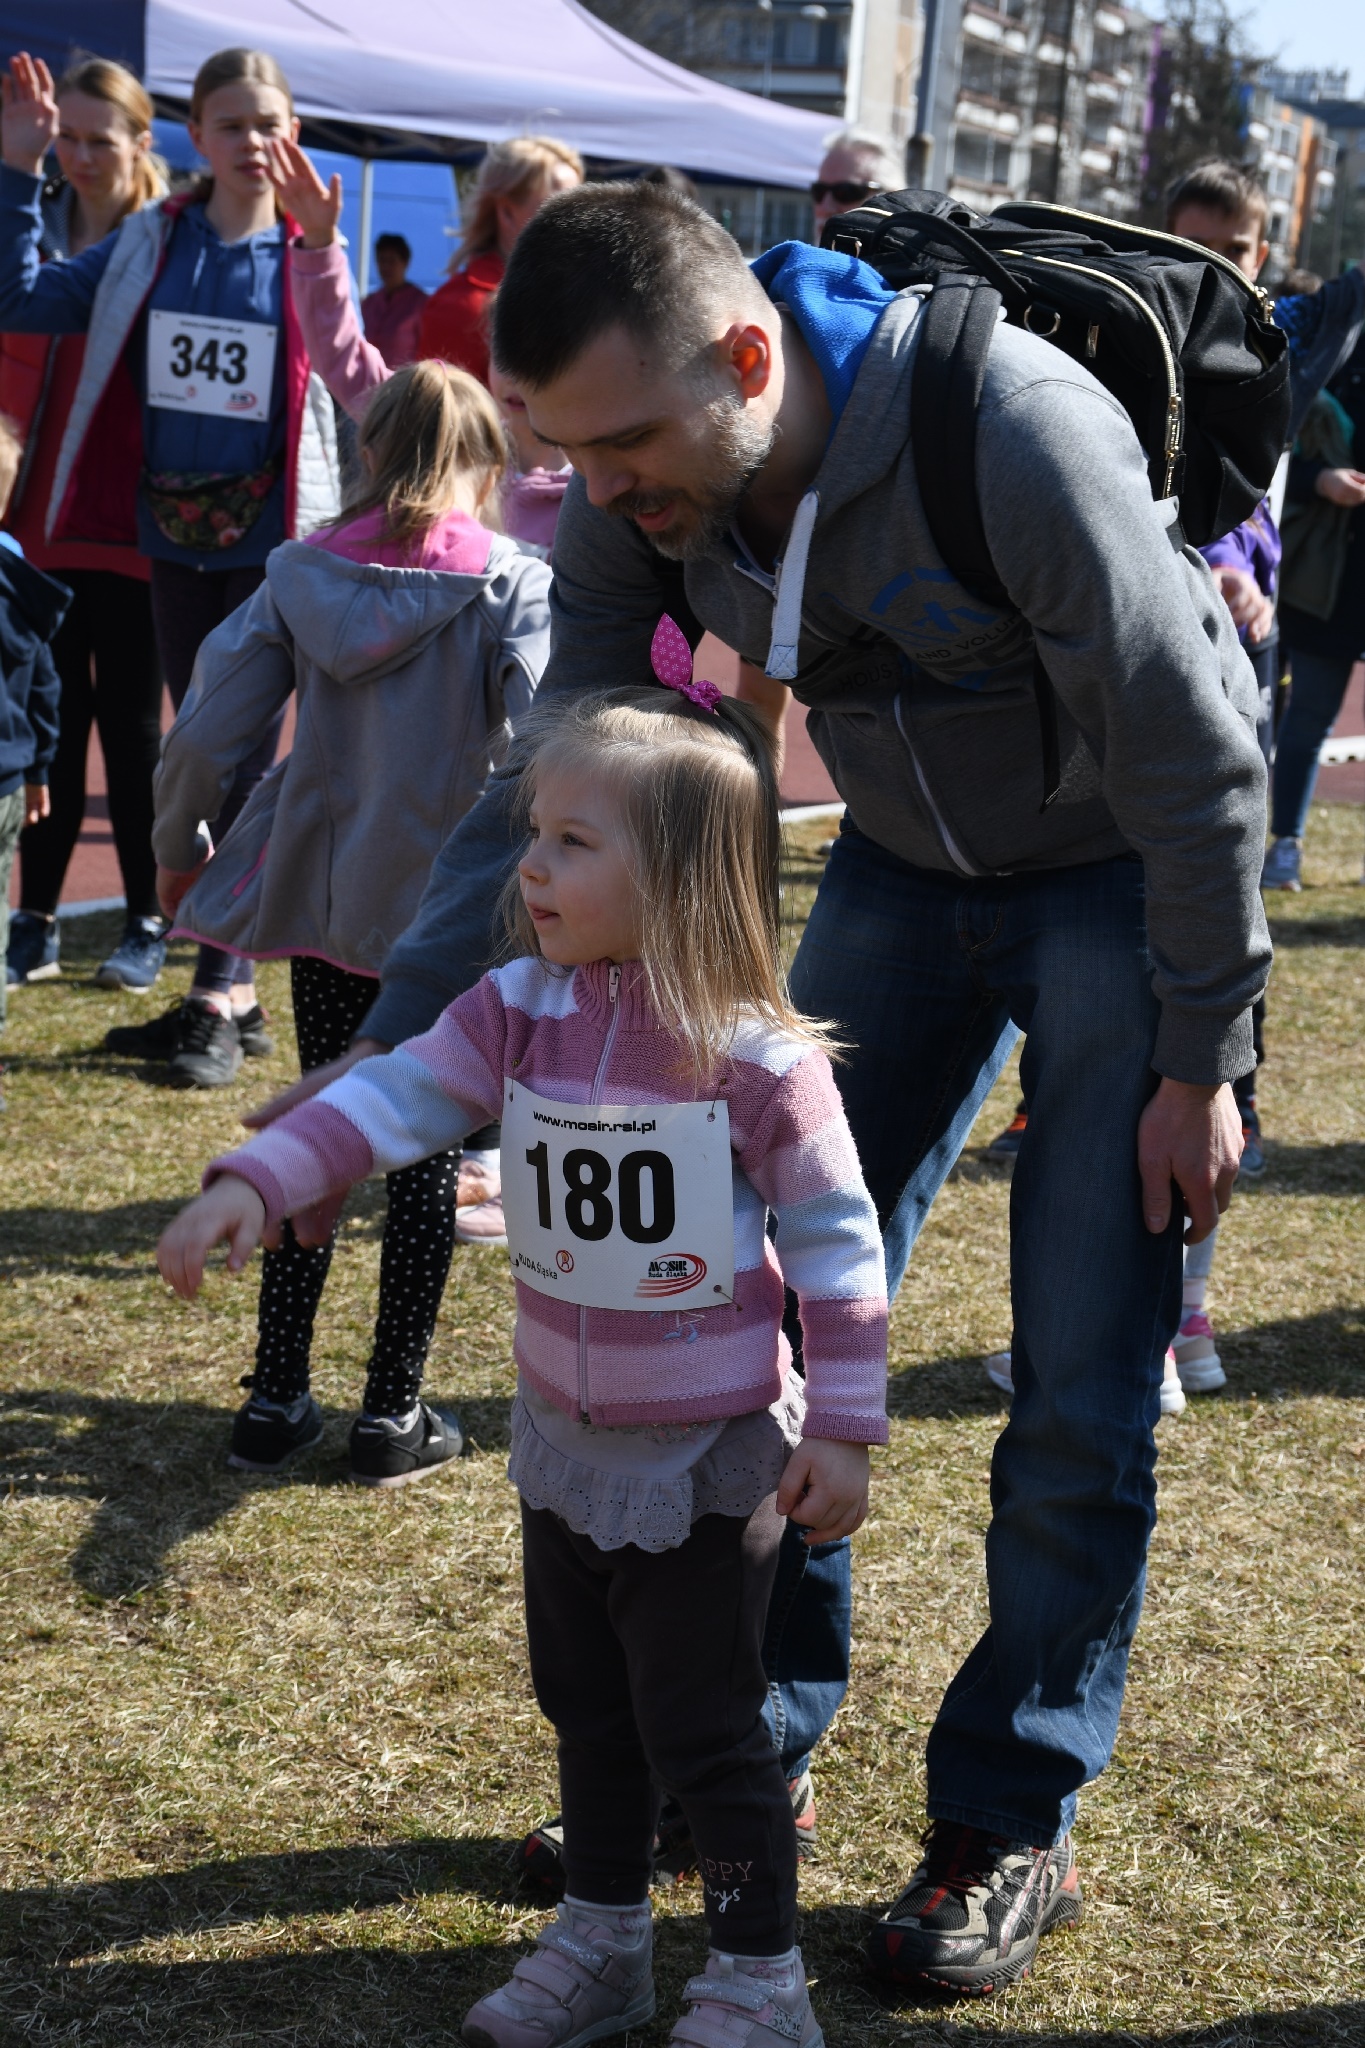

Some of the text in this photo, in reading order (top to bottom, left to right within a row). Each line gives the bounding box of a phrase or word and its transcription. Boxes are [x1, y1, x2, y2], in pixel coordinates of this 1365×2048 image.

[171, 334, 247, 385] 343
[915, 649, 951, 660] AND
[533, 1111, 656, 1134] www.mosir.rsl.pl
[526, 1141, 675, 1243] 180
